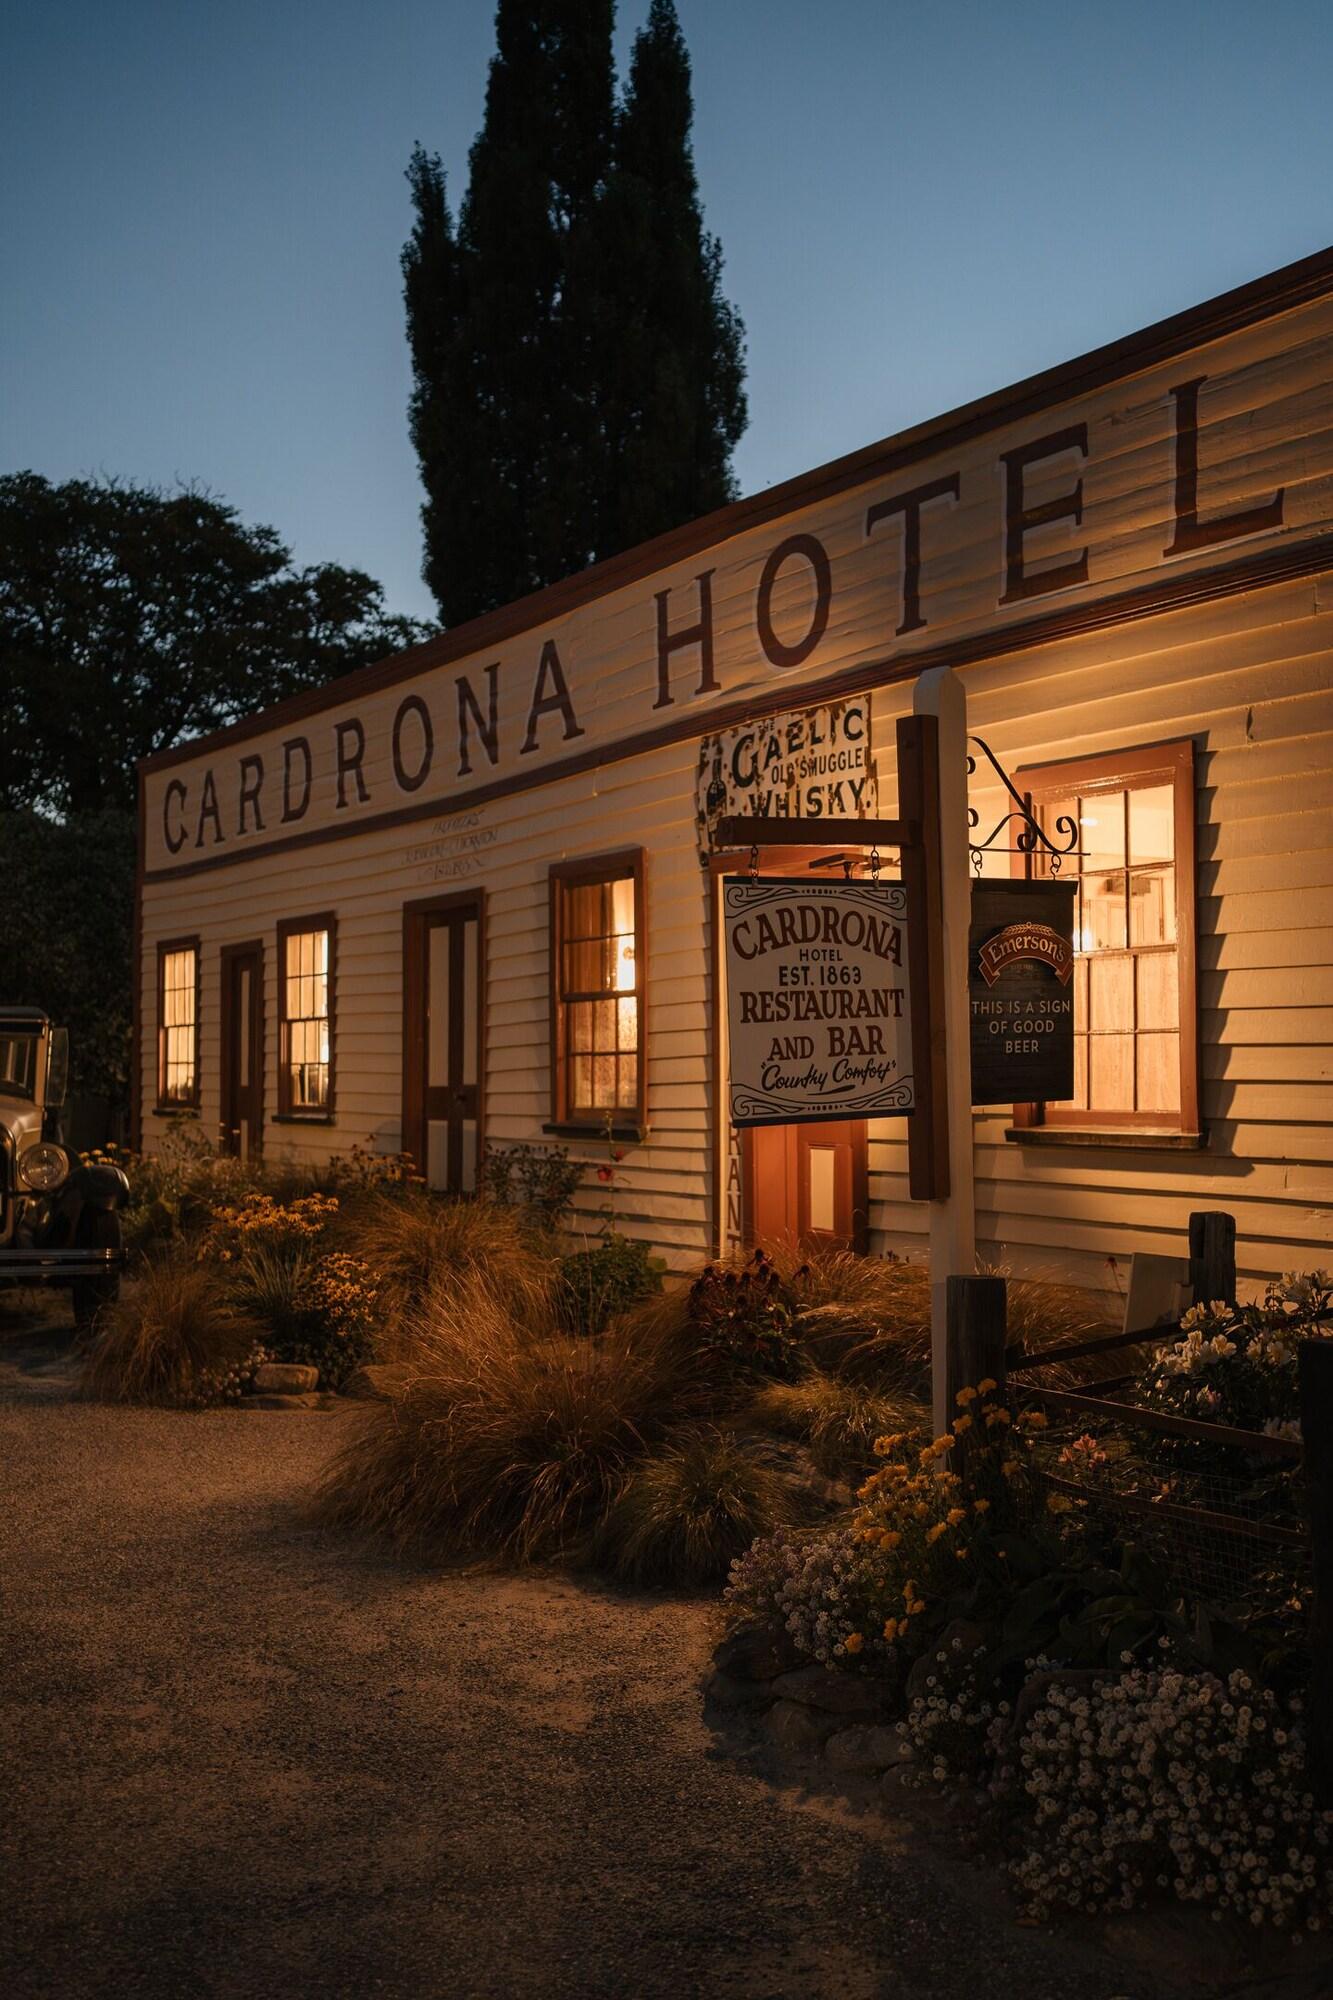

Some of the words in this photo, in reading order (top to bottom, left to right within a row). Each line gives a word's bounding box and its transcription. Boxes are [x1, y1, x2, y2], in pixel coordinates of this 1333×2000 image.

[163, 638, 585, 854] CARDRONA
[653, 375, 1285, 709] HOTEL
[732, 905, 903, 967] CARDRONA
[799, 949, 843, 962] HOTEL
[987, 935, 1066, 964] Emerson's
[778, 966, 814, 986] EST.
[820, 965, 861, 985] 1863
[739, 988, 904, 1024] RESTAURANT
[971, 1000, 1003, 1015] THIS
[1009, 1000, 1021, 1014] IS
[1026, 1000, 1035, 1014] A
[1039, 1000, 1071, 1013] SIGN
[988, 1020, 1008, 1034] OF
[1013, 1020, 1055, 1033] GOOD
[766, 1035, 815, 1062] AND
[826, 1025, 887, 1058] BAR
[1005, 1039, 1040, 1053] BEER
